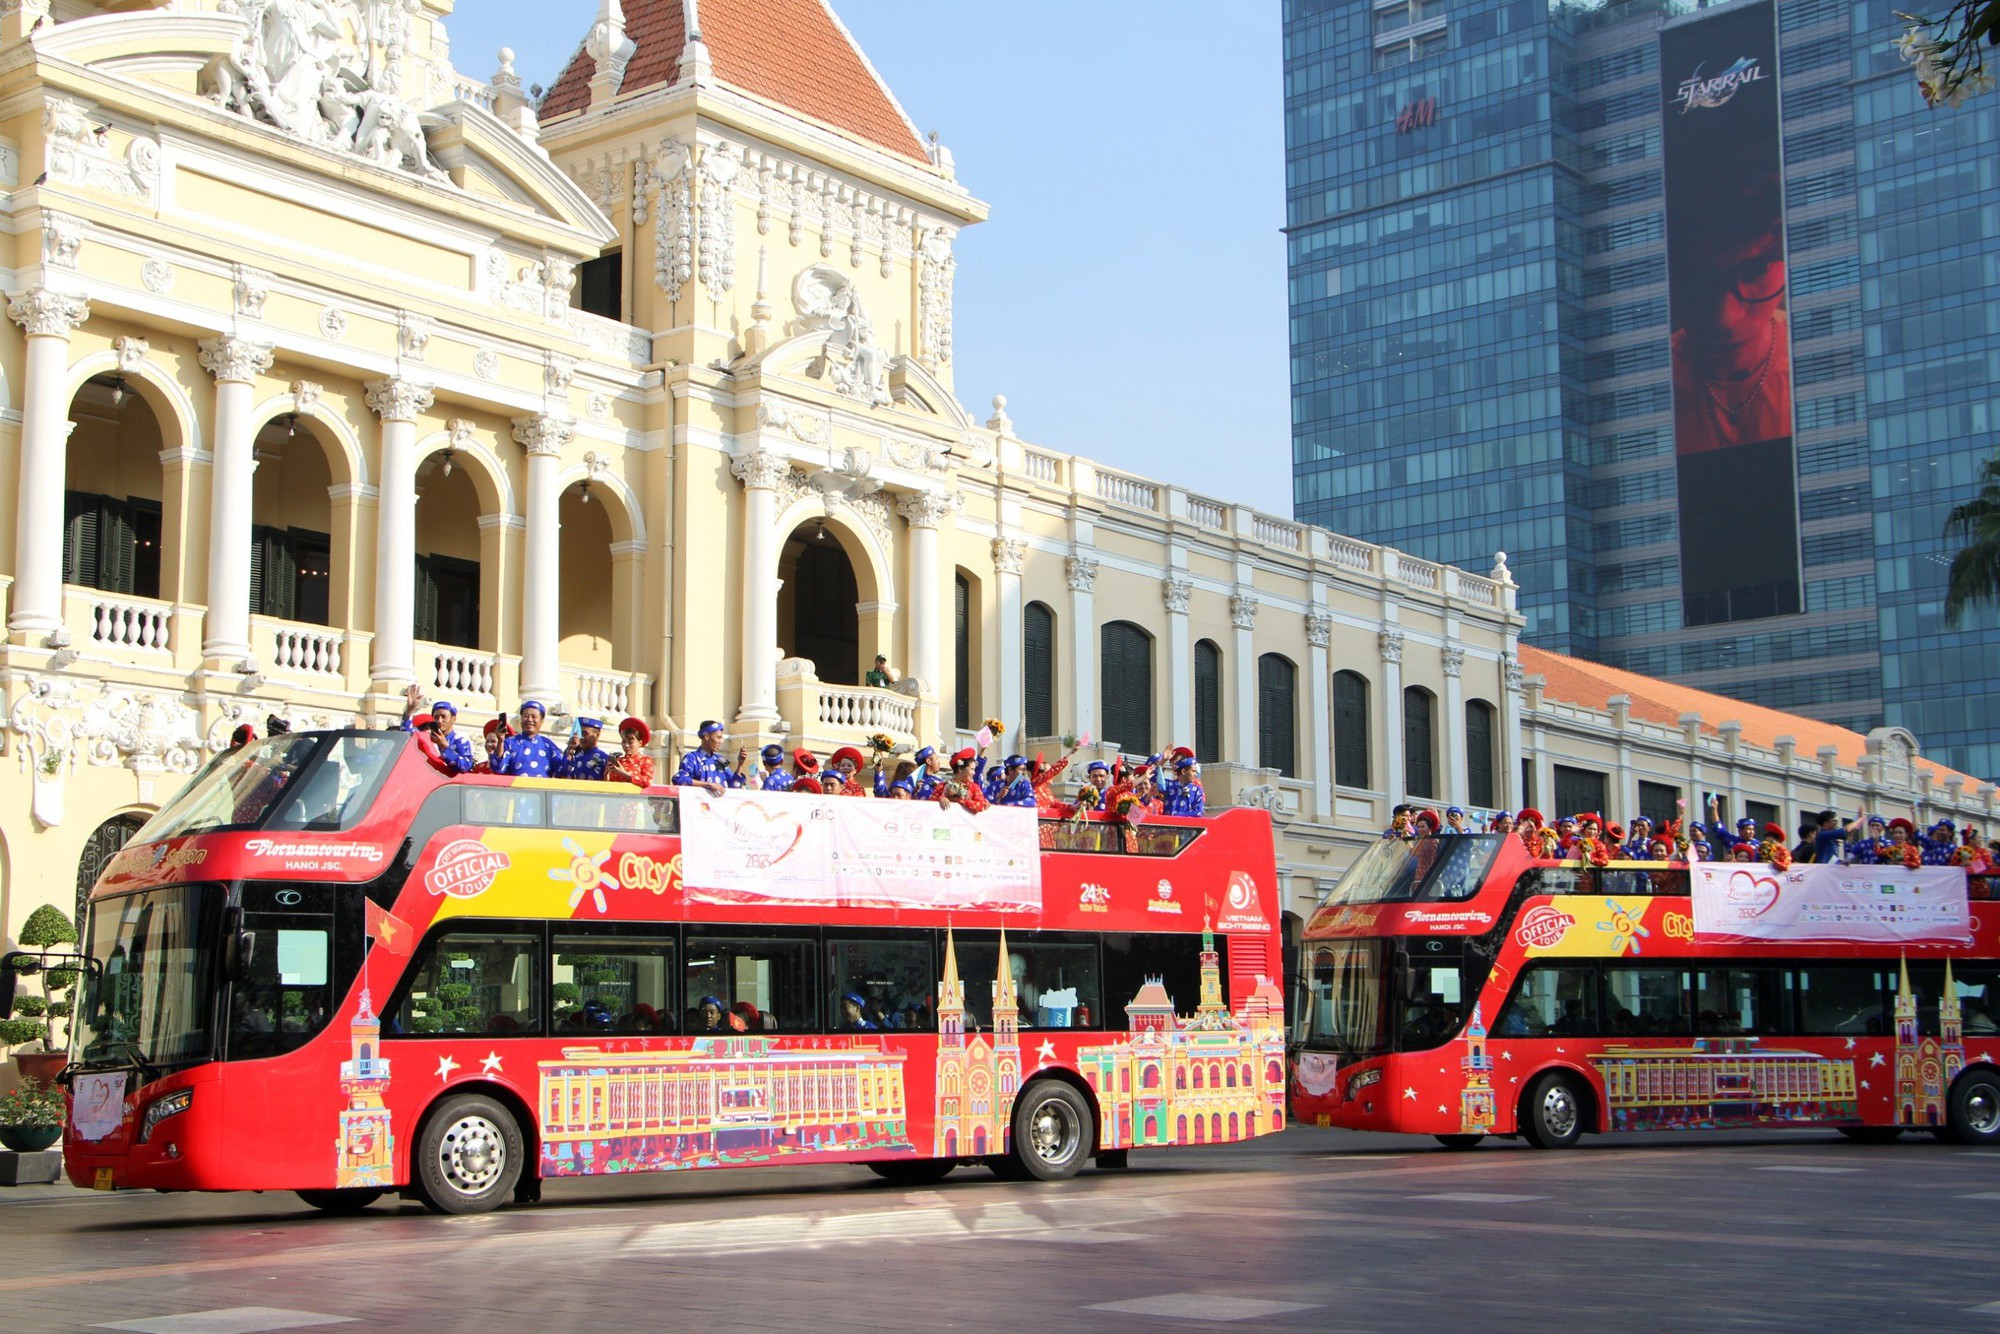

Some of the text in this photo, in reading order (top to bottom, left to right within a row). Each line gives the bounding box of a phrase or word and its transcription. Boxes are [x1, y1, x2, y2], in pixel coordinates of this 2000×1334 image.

[1395, 96, 1435, 135] H&M
[245, 839, 384, 862] Vietnamtourism
[285, 861, 344, 870] HANOI JSC.
[434, 853, 506, 888] OFFICIAL
[459, 875, 491, 894] TOUR
[1225, 914, 1263, 923] VIETNAM
[1522, 915, 1573, 941] OFFICIAL
[1539, 931, 1563, 945] TOUR
